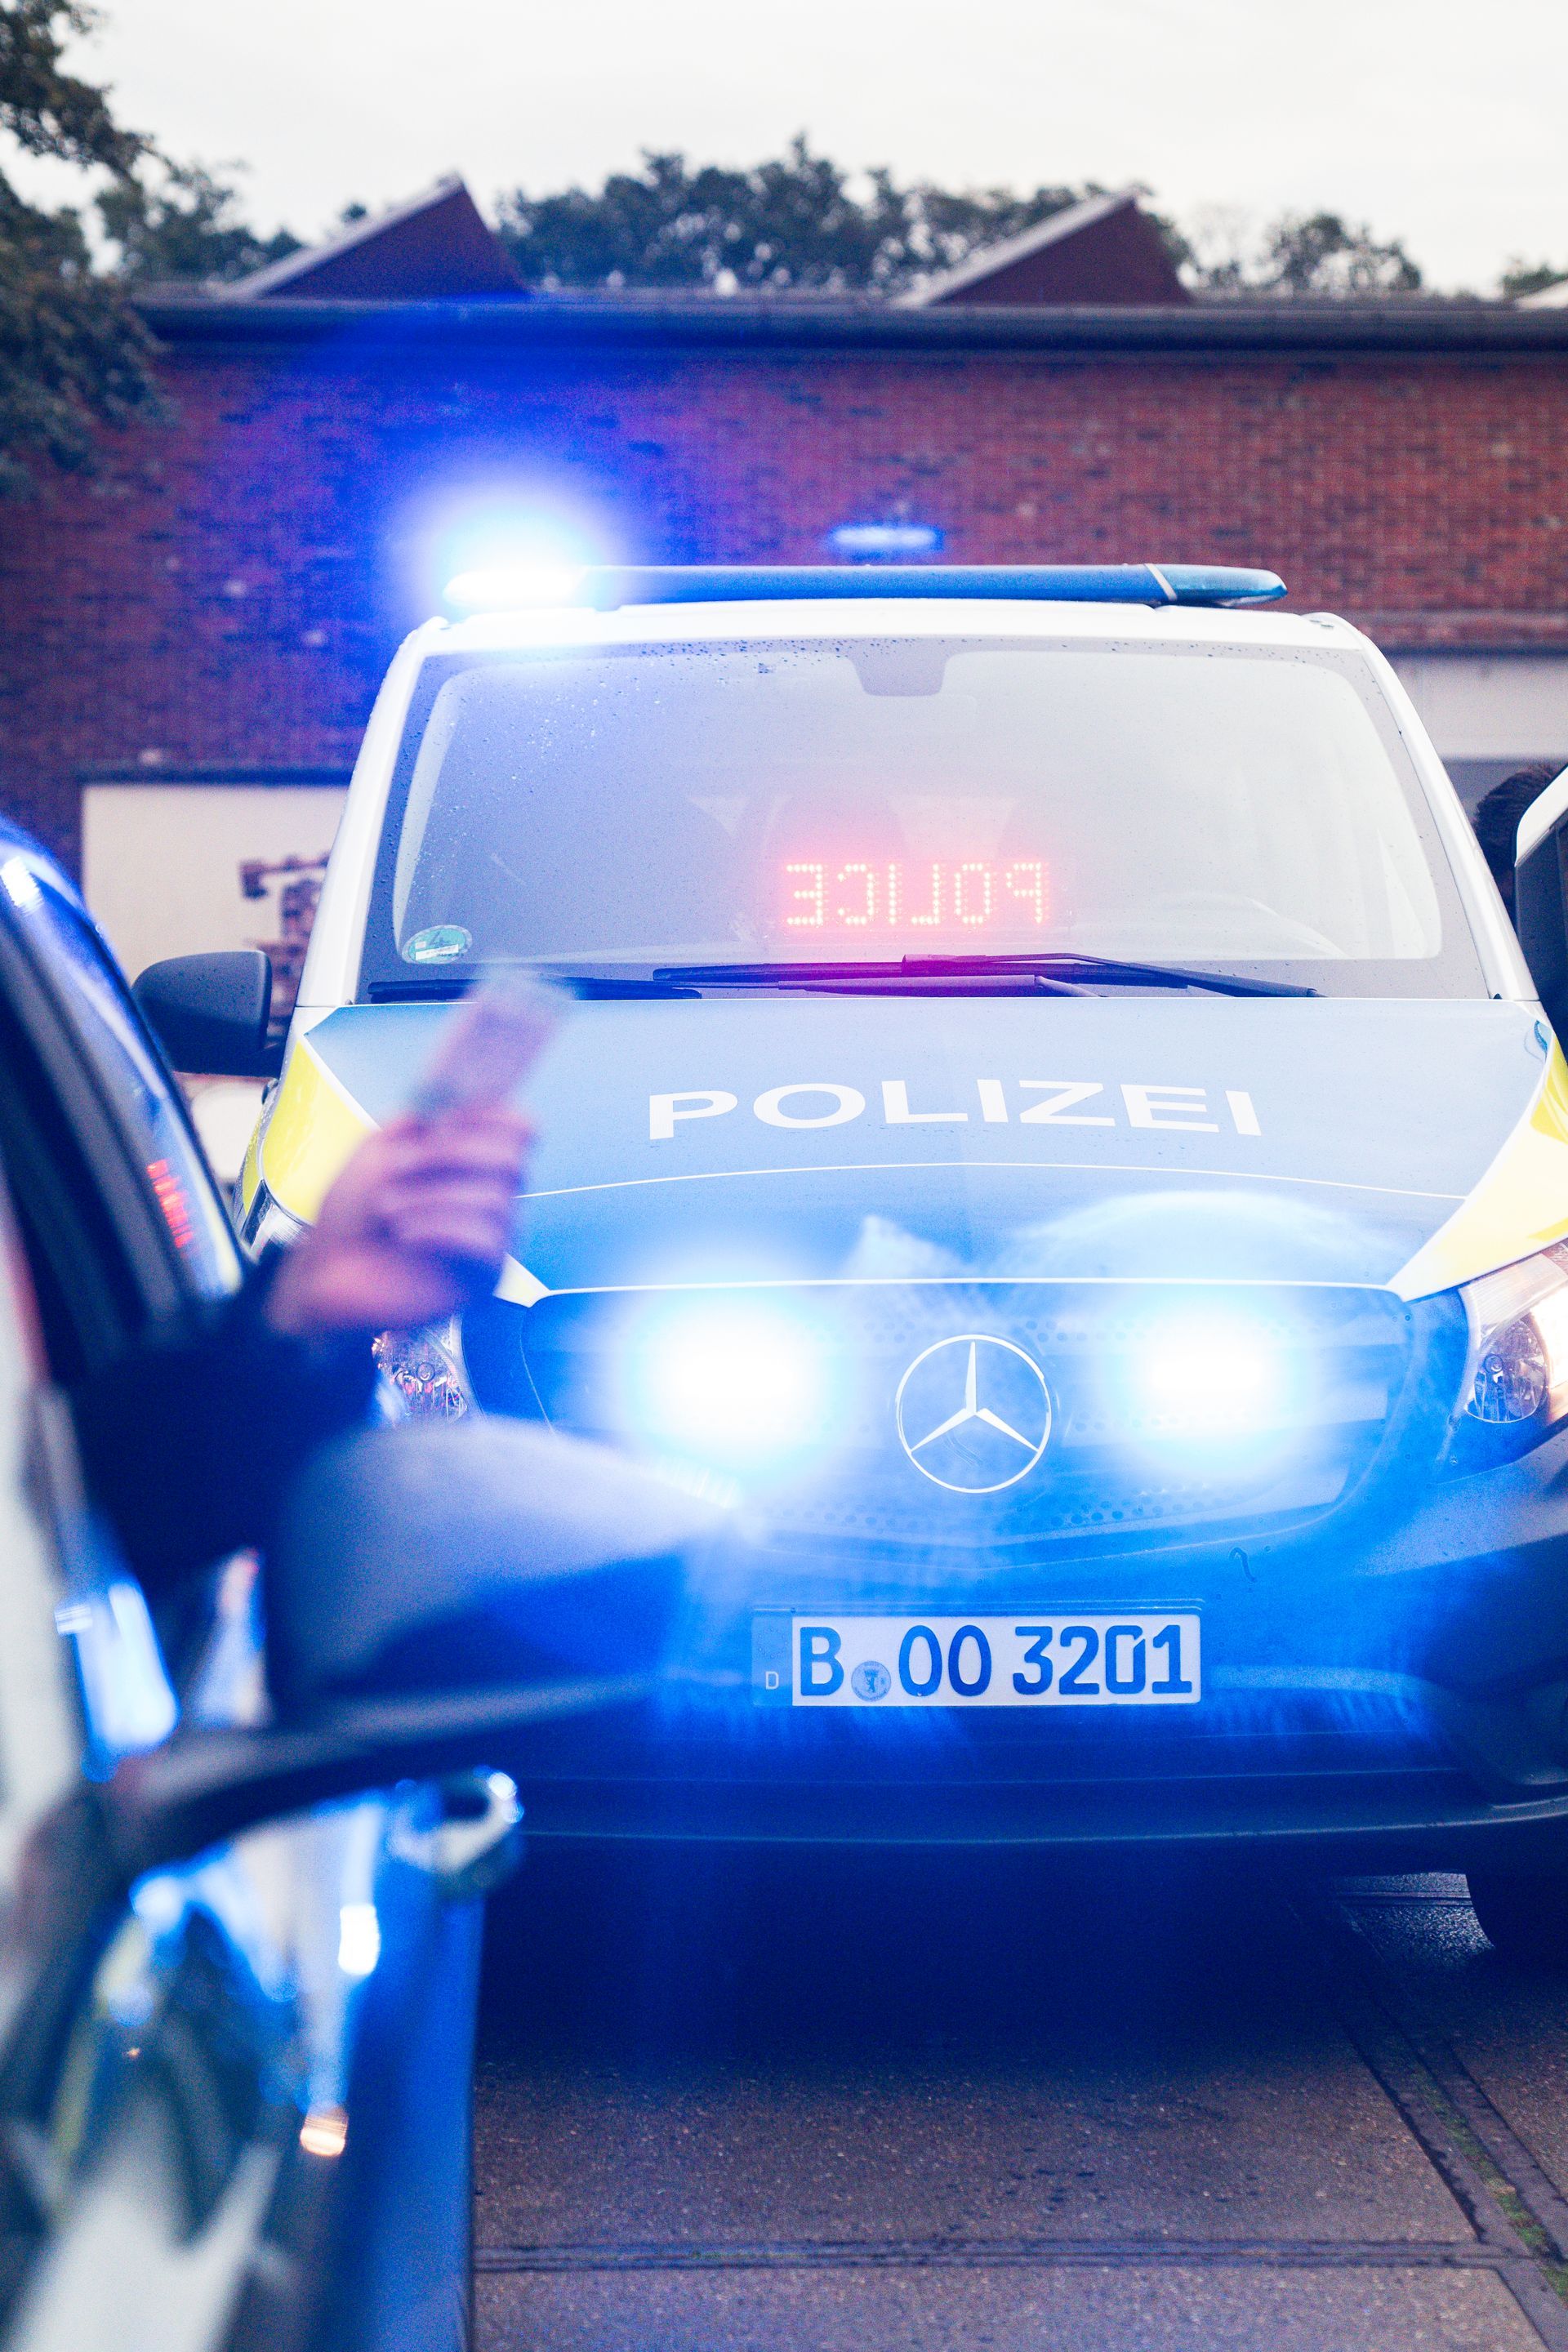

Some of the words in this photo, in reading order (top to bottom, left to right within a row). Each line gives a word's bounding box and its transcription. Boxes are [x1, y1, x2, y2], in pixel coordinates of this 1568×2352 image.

[648, 1079, 1263, 1141] POLIZEI
[765, 1671, 780, 1690] D
[800, 1626, 844, 1696] B
[1012, 1624, 1193, 1695] 3201
